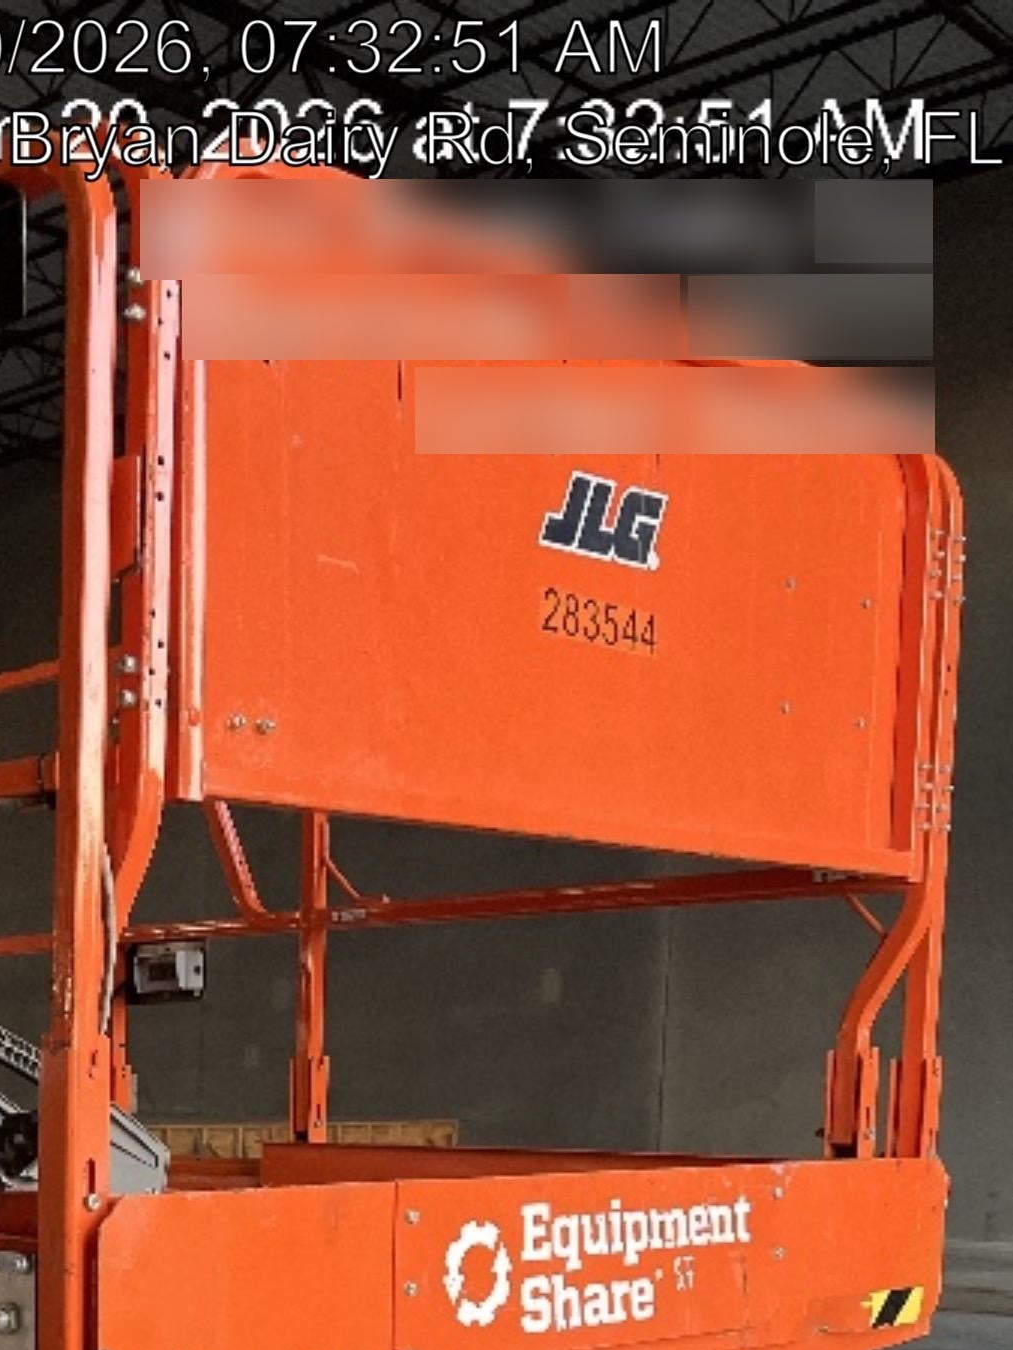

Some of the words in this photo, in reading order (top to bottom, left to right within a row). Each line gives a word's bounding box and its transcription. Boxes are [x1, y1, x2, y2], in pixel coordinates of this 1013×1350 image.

[538, 471, 669, 571] JLG
[542, 586, 657, 655] 283544
[520, 1194, 752, 1272] Equipment
[520, 1274, 656, 1334] Share
